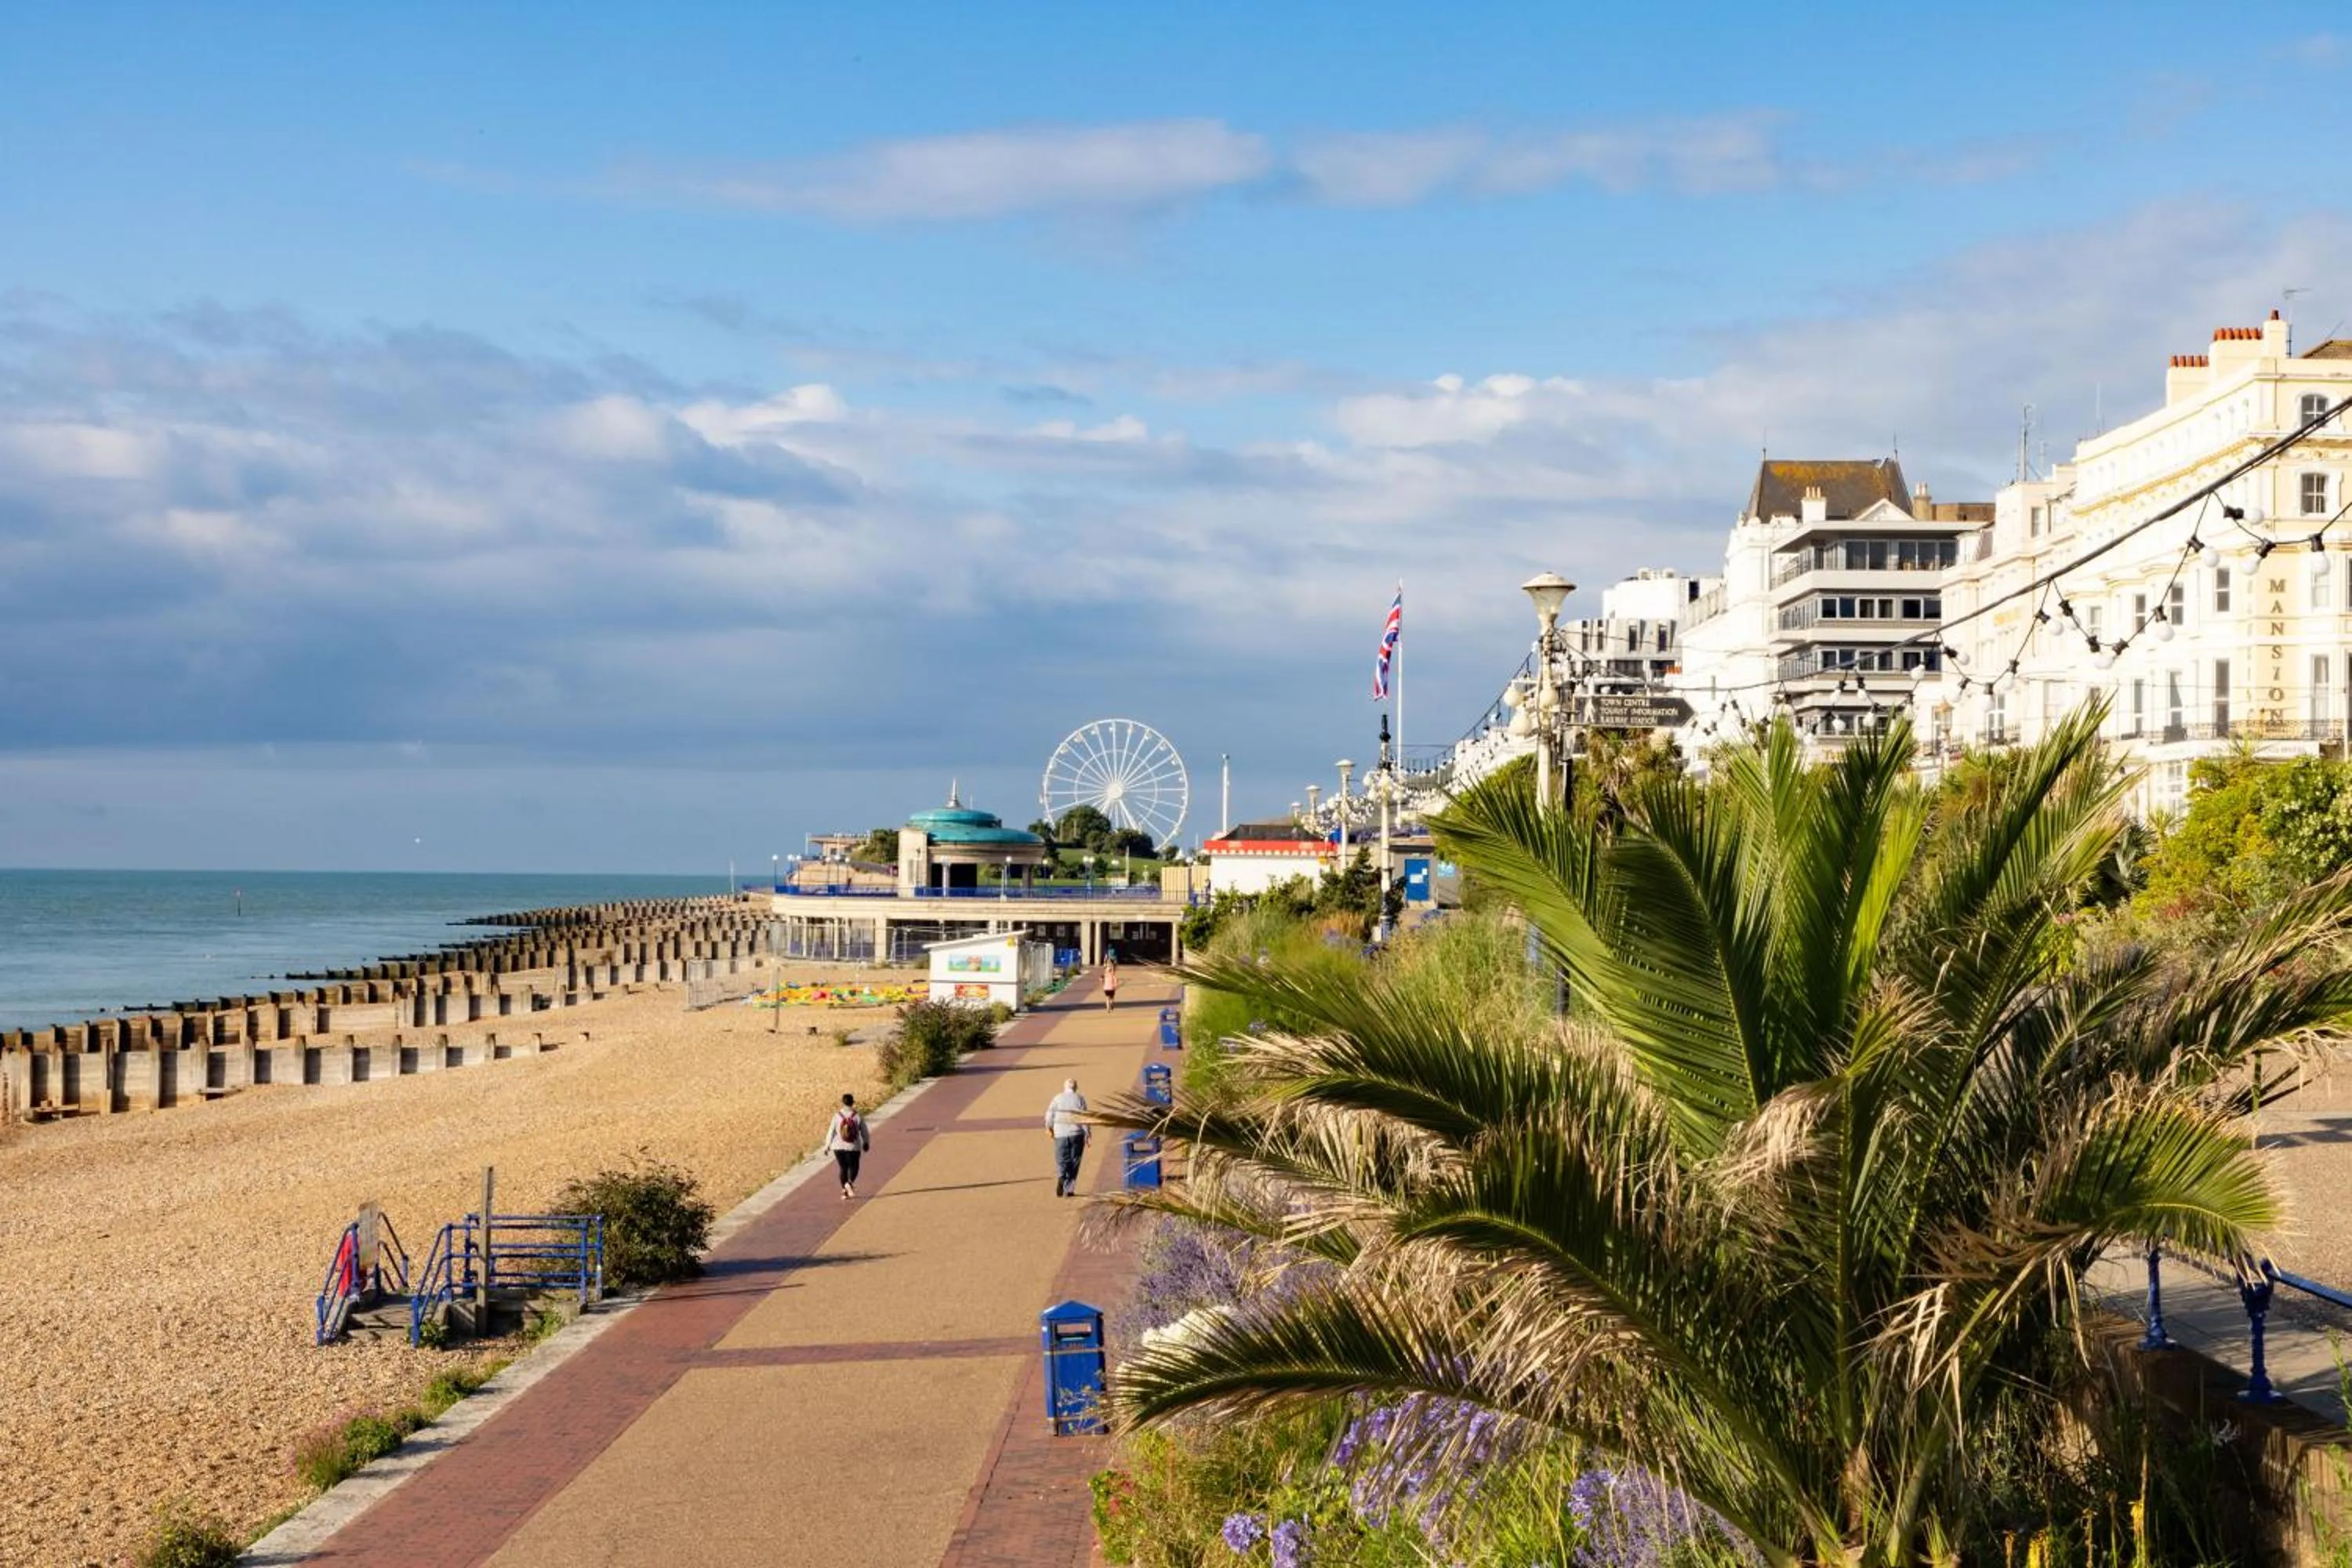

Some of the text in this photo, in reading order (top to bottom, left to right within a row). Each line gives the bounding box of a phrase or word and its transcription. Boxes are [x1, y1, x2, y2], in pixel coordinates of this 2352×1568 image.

[2268, 579, 2285, 724] MANSION
[1600, 707, 1679, 716] TOURIST INFORMATION
